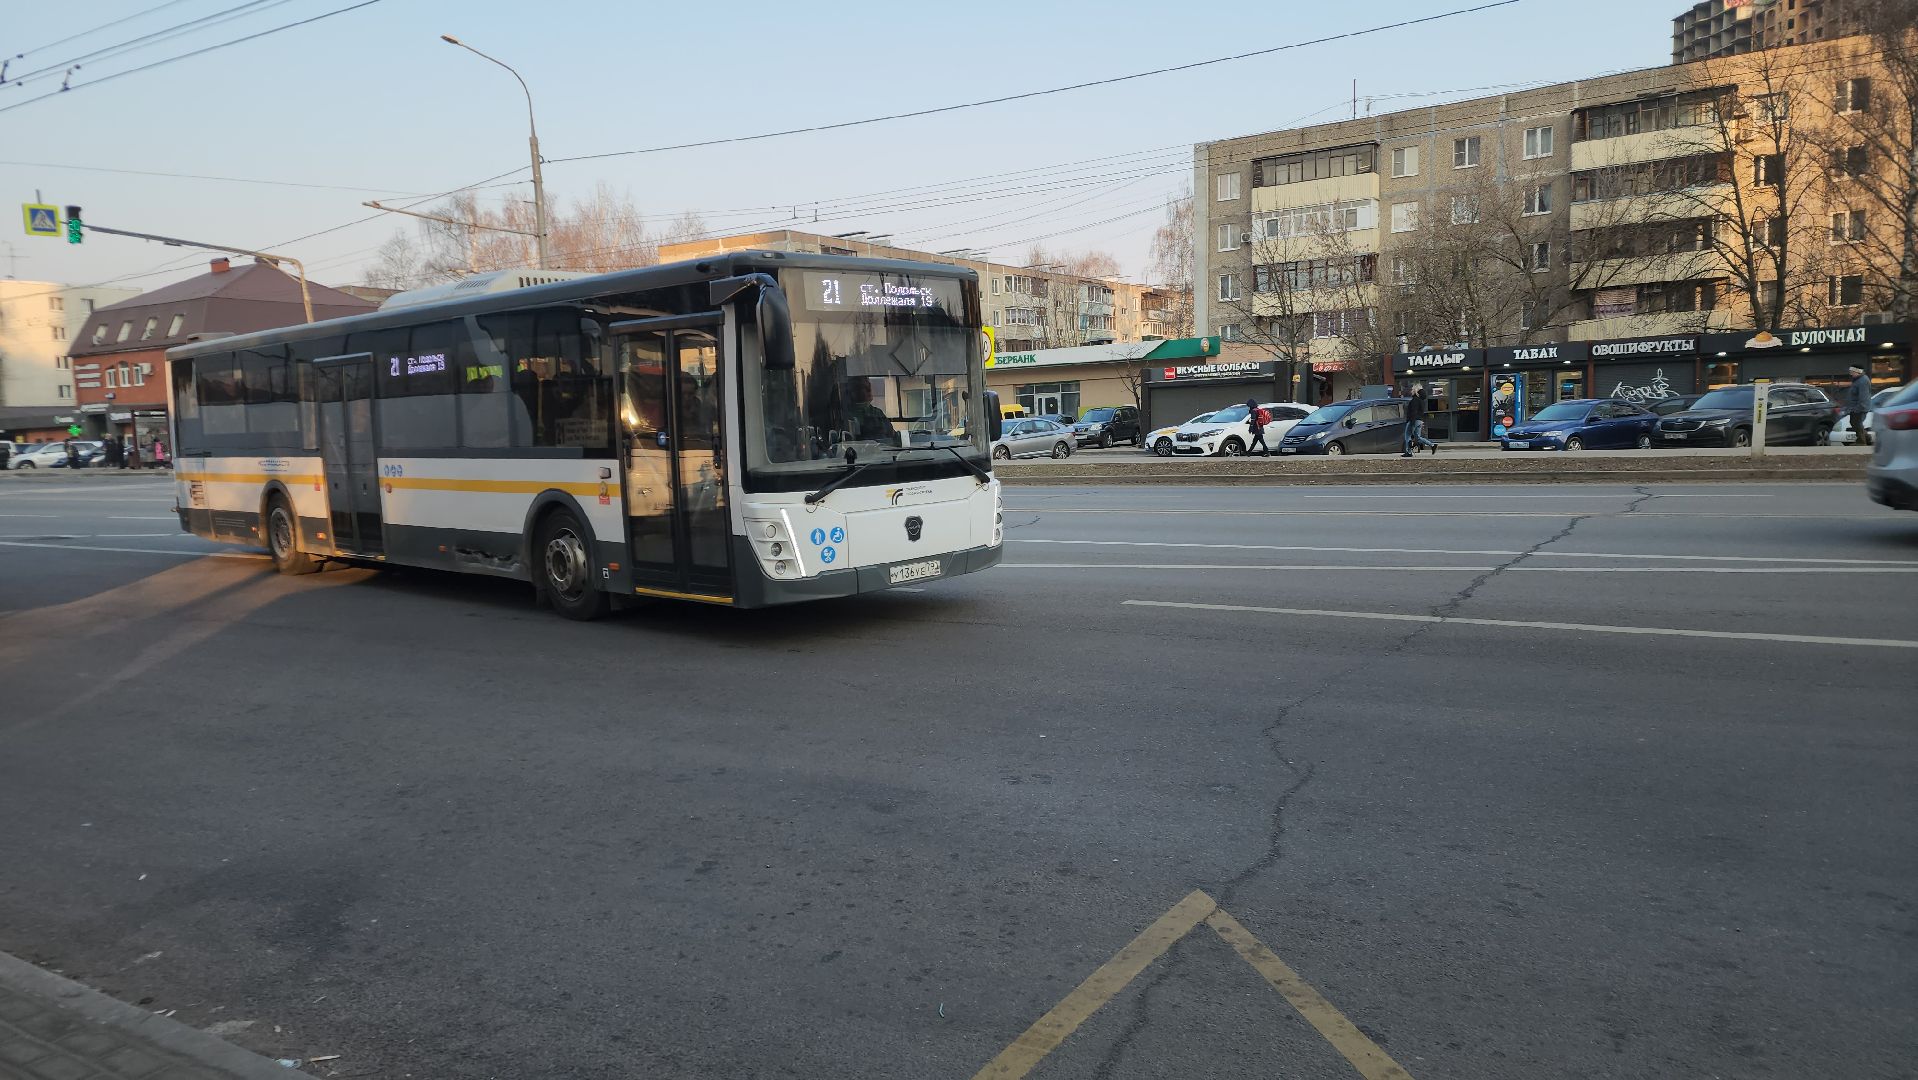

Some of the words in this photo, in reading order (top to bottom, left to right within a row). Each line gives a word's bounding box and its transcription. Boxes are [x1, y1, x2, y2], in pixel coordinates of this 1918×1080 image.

[822, 280, 840, 304] 21
[885, 283, 933, 295] Подольск
[861, 293, 916, 306] Доллежаля
[922, 296, 933, 306] 19
[1791, 328, 1866, 345] БУЛОЧНАЯ
[1408, 353, 1466, 367] ТАНДЫР
[1513, 347, 1558, 360] ТАБАК
[1176, 364, 1216, 375] ВКУСНЫЕ
[1217, 362, 1260, 373] КОЛБАСЫ
